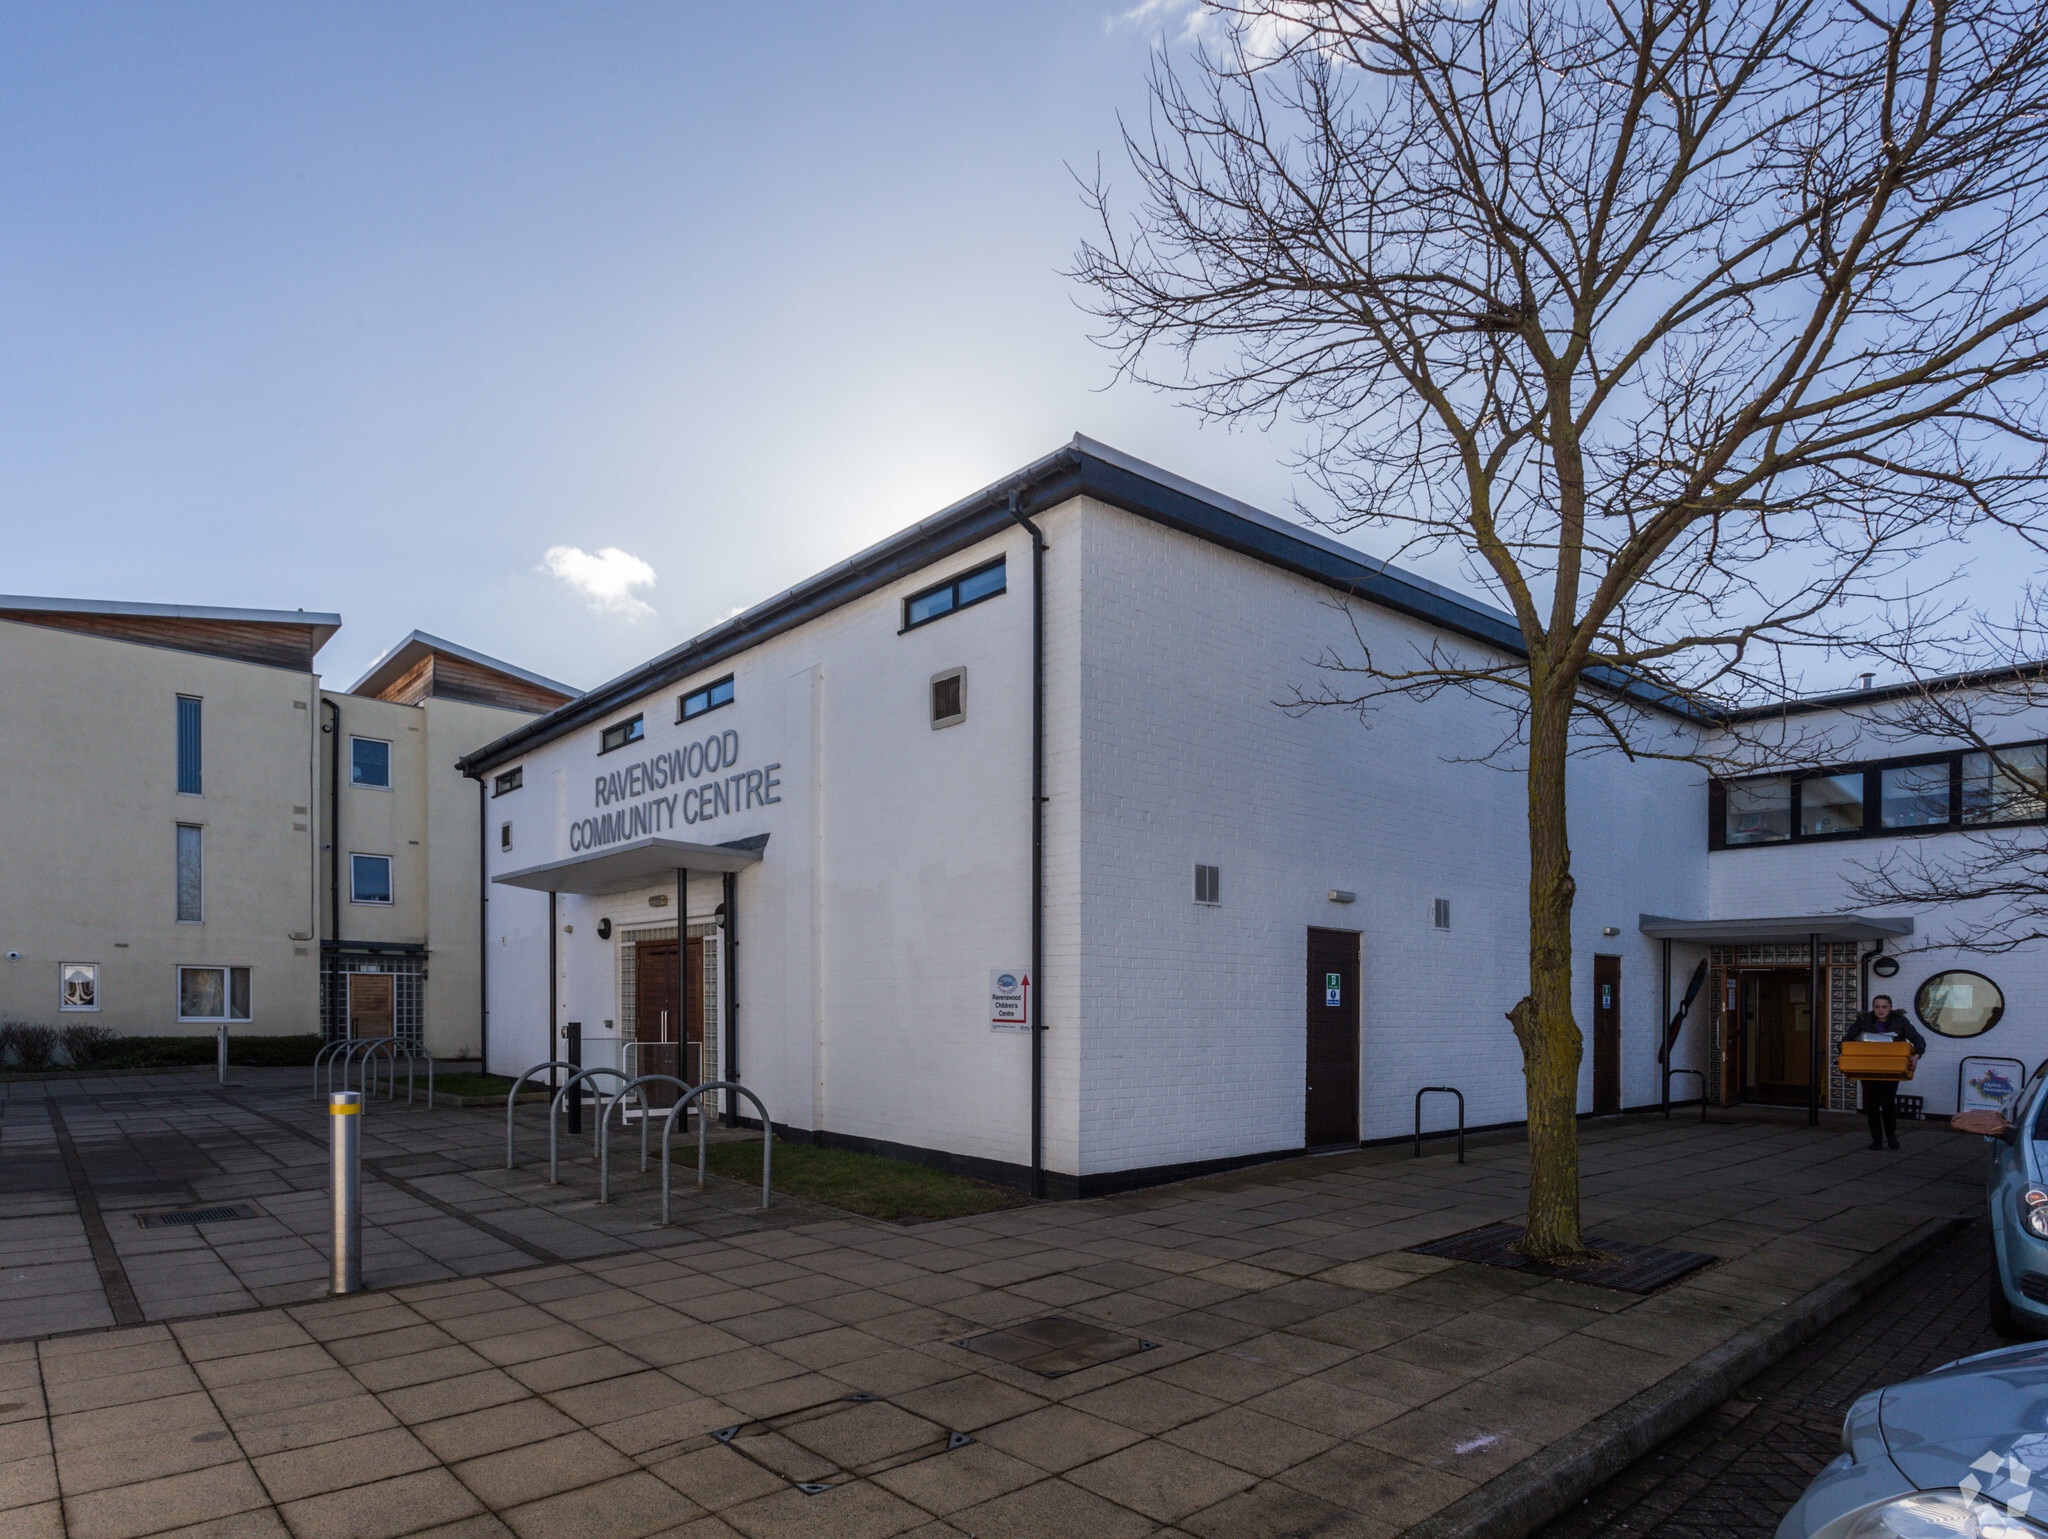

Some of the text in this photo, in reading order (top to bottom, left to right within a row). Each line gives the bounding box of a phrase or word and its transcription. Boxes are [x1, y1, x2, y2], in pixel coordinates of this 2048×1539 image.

[570, 762, 781, 852] COMMUNITY CENTRE
[595, 729, 738, 807] RAVENSWOOD
